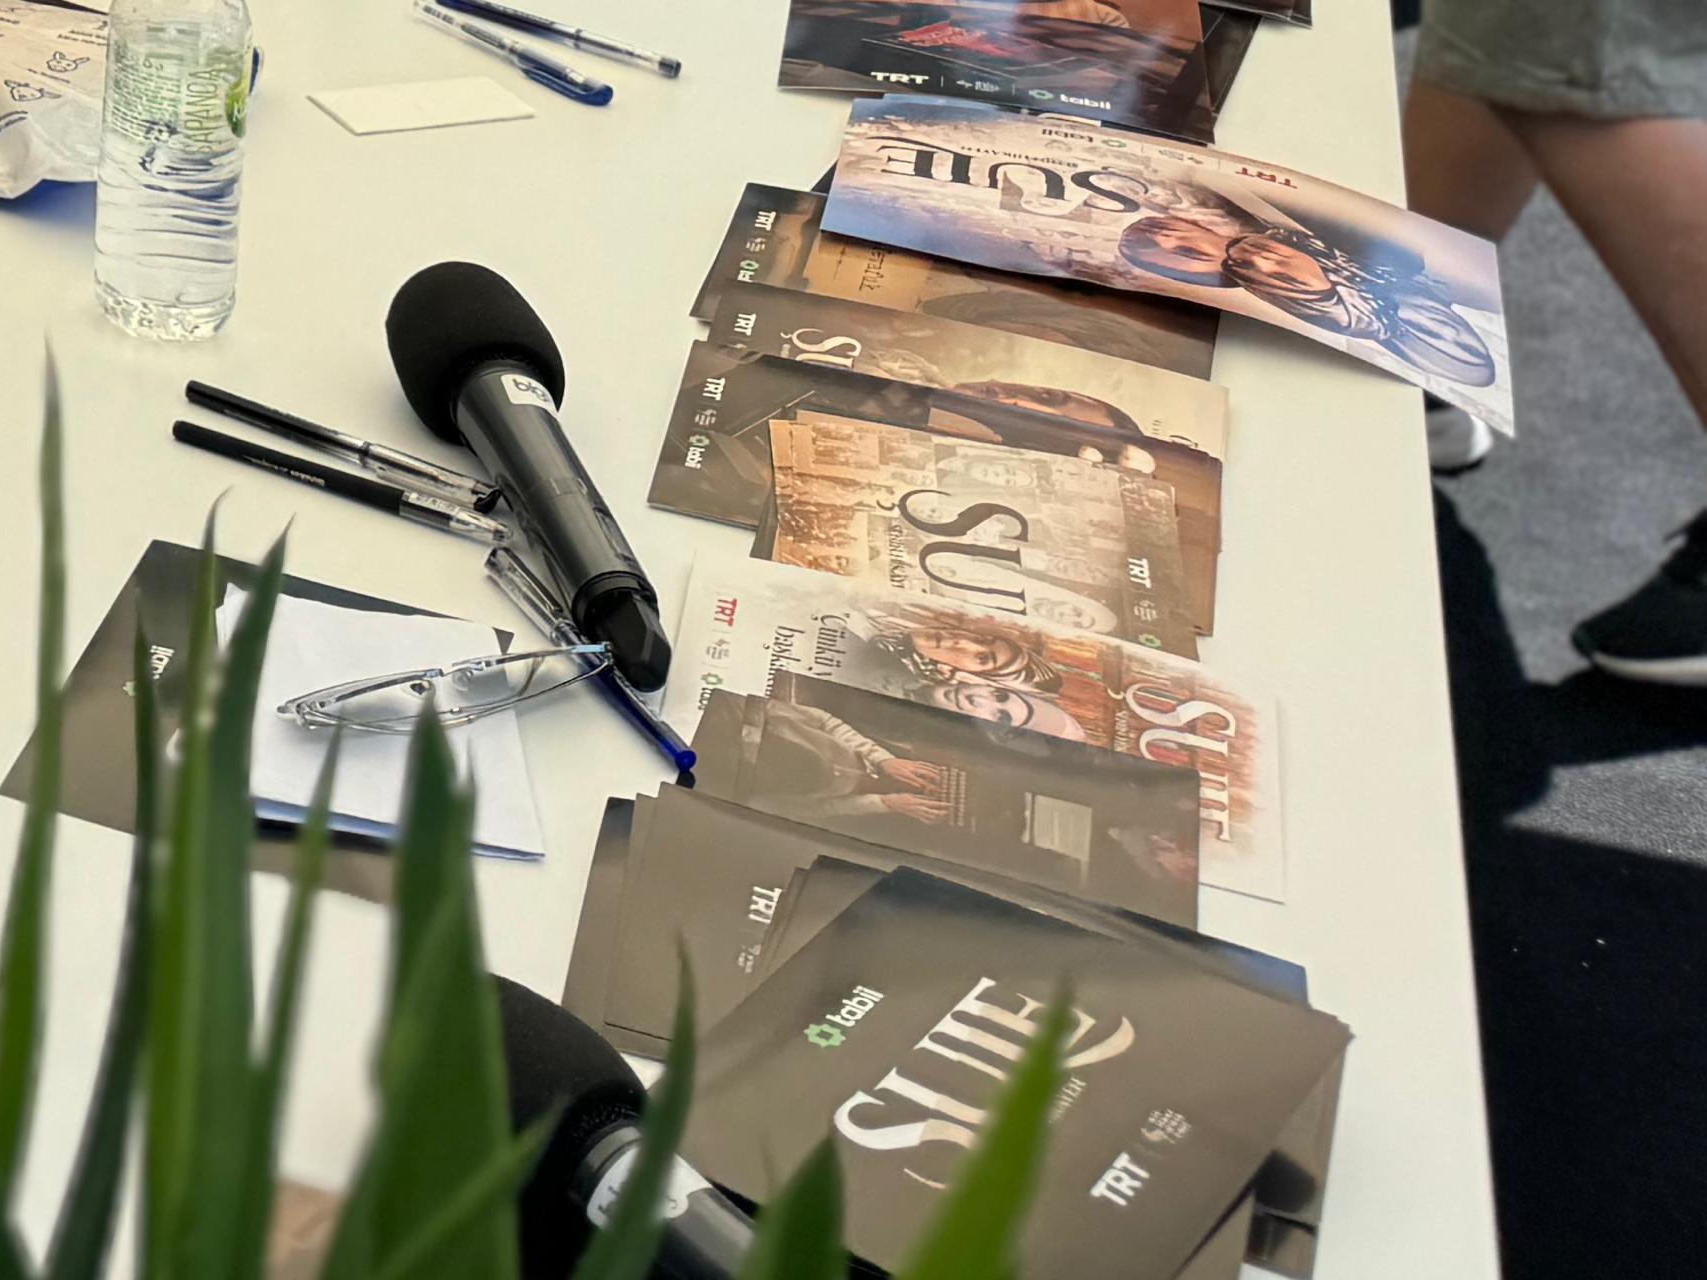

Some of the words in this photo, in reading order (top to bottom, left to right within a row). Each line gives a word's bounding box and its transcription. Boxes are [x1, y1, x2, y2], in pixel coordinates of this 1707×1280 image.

[871, 71, 929, 85] TRT
[1059, 92, 1112, 111] tabii
[1235, 166, 1298, 190] TRT
[754, 210, 776, 231] TRT
[734, 313, 757, 336] TRT
[702, 377, 726, 401] TRT
[1127, 557, 1151, 589] TRT
[714, 598, 738, 627] TRT
[826, 985, 885, 1029] tabii
[1091, 1152, 1151, 1207] TRT
